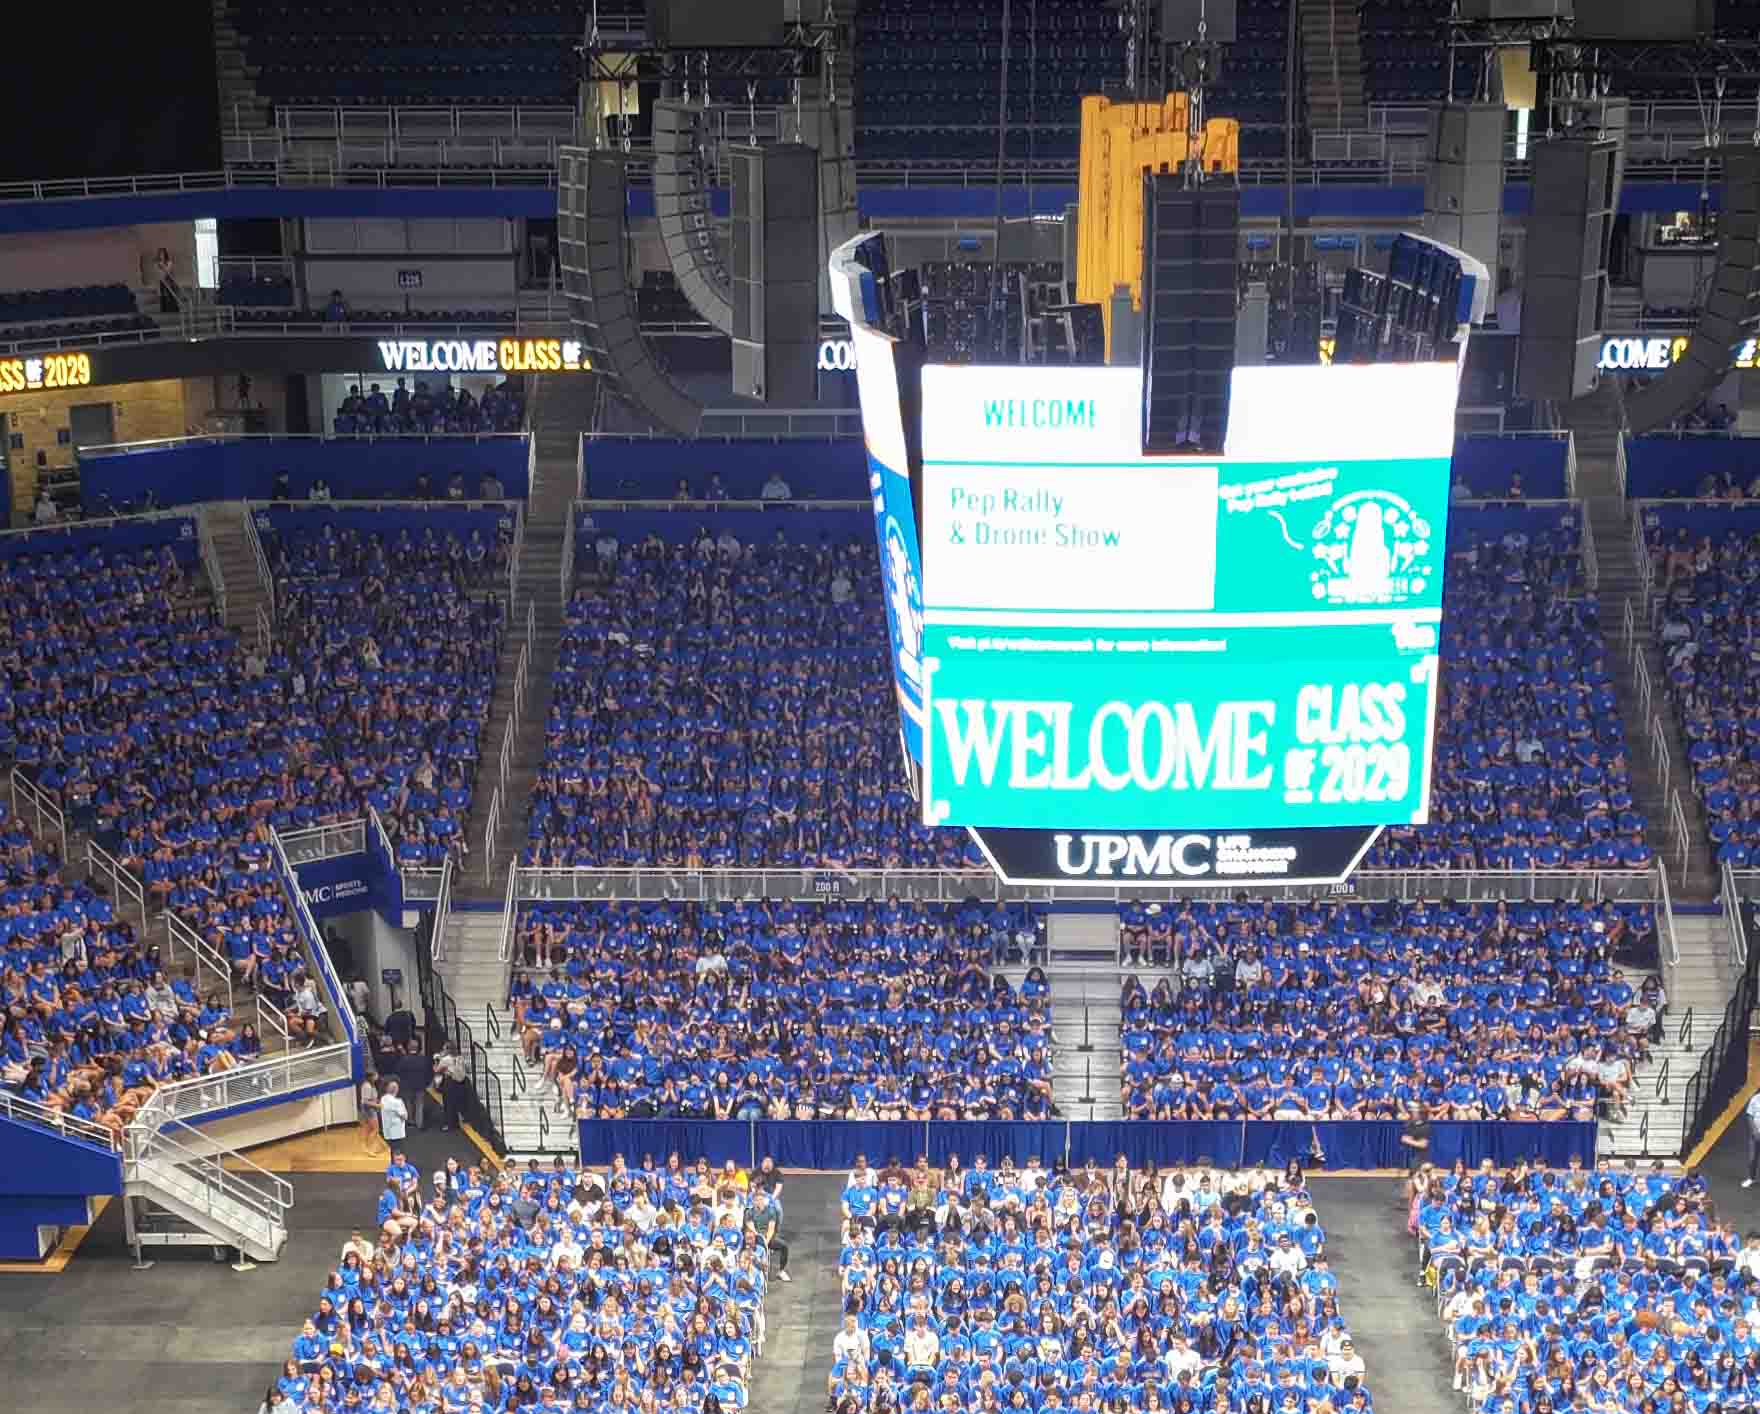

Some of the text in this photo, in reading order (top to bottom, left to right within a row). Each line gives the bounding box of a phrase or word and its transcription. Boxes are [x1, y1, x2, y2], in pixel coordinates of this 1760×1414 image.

[44, 354, 90, 387] 2029
[378, 341, 497, 370] WELCOME
[500, 340, 561, 370] CLASS
[983, 399, 1097, 430] WELCOME
[949, 487, 1064, 518] Pep Rally
[948, 520, 1121, 549] & Drone Show
[935, 681, 1407, 791] WELCOME CLASS
[1284, 743, 1411, 804] OF 2029
[1054, 834, 1211, 875] UPMC
